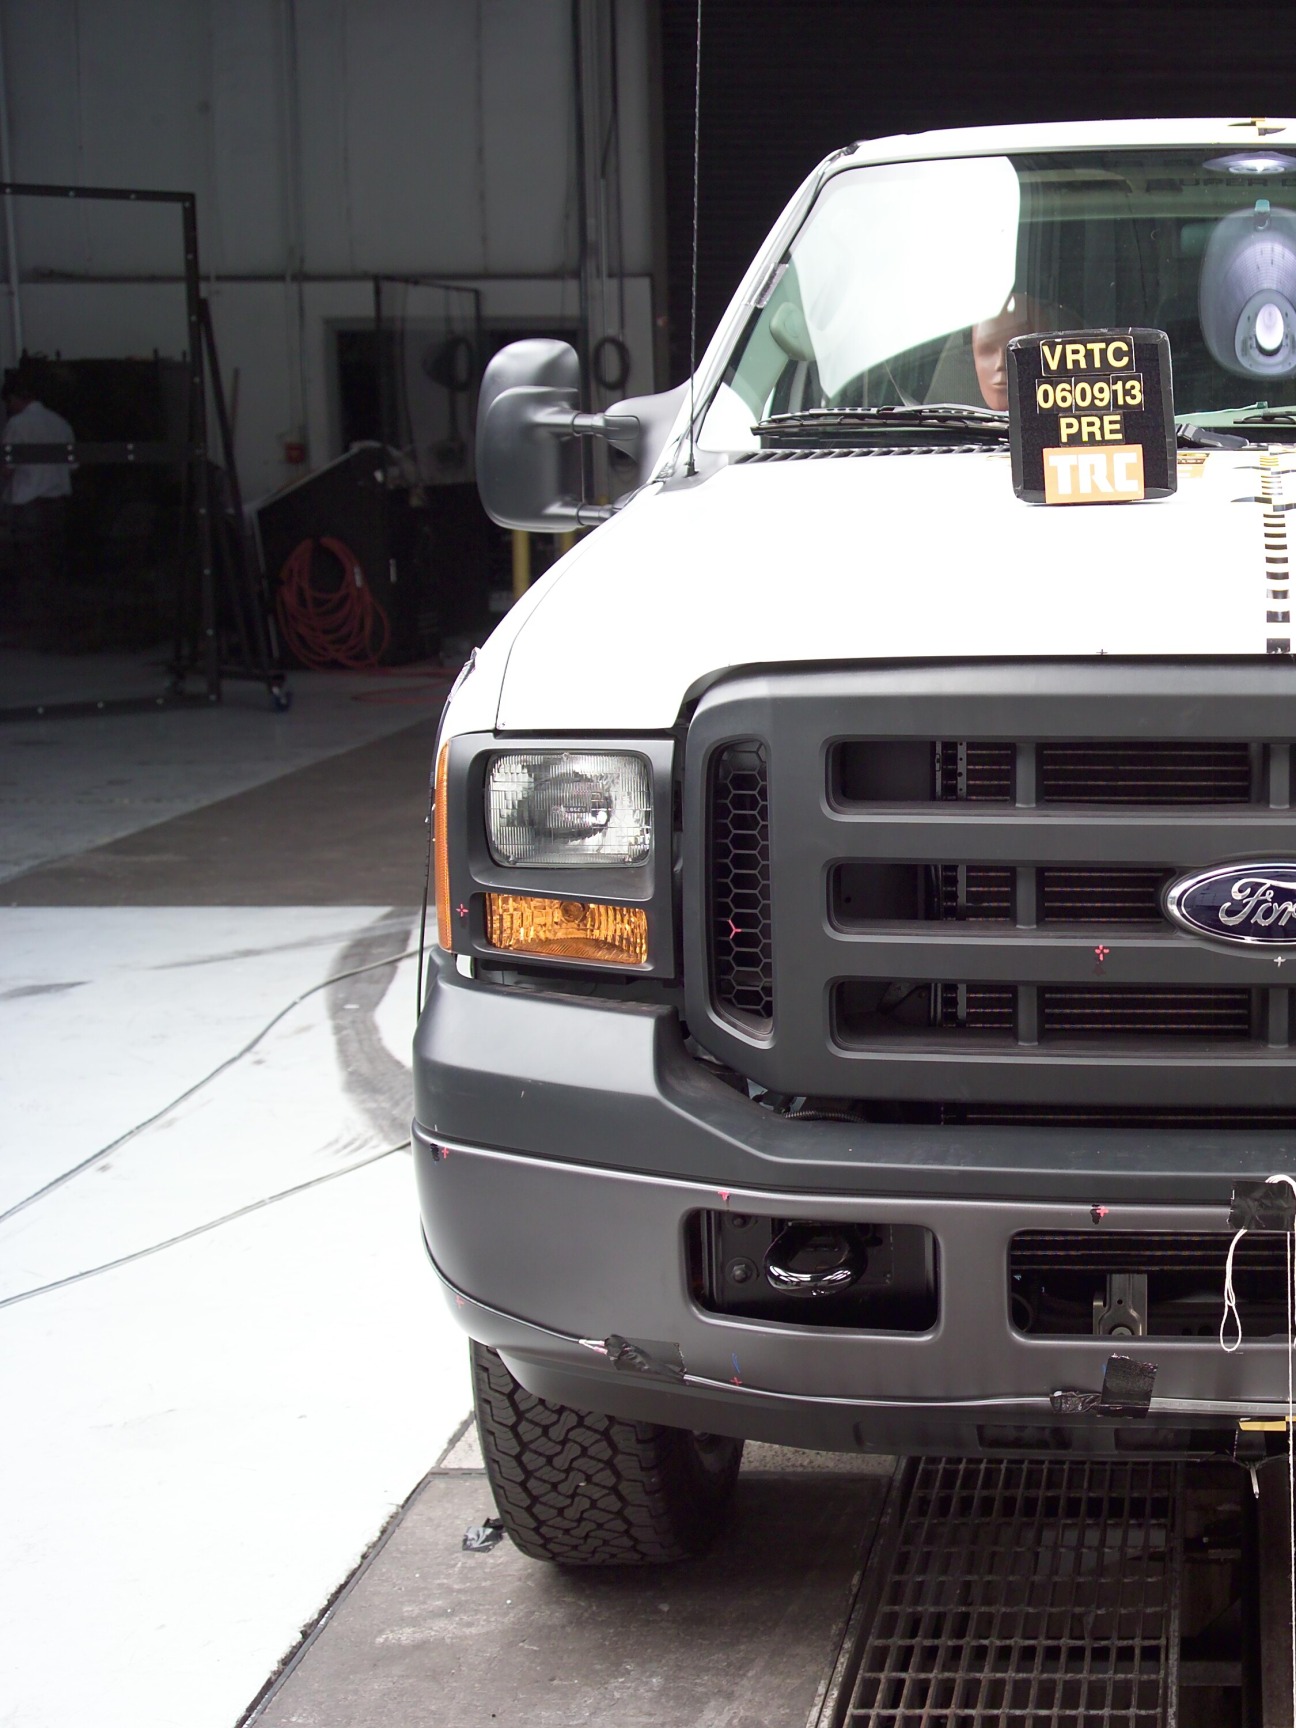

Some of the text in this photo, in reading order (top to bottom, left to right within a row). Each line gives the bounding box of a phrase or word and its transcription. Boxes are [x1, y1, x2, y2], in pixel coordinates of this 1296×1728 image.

[1041, 341, 1130, 371] VRTC
[1036, 380, 1143, 409] 060913
[1059, 415, 1123, 443] PRE
[1049, 452, 1139, 495] TRC
